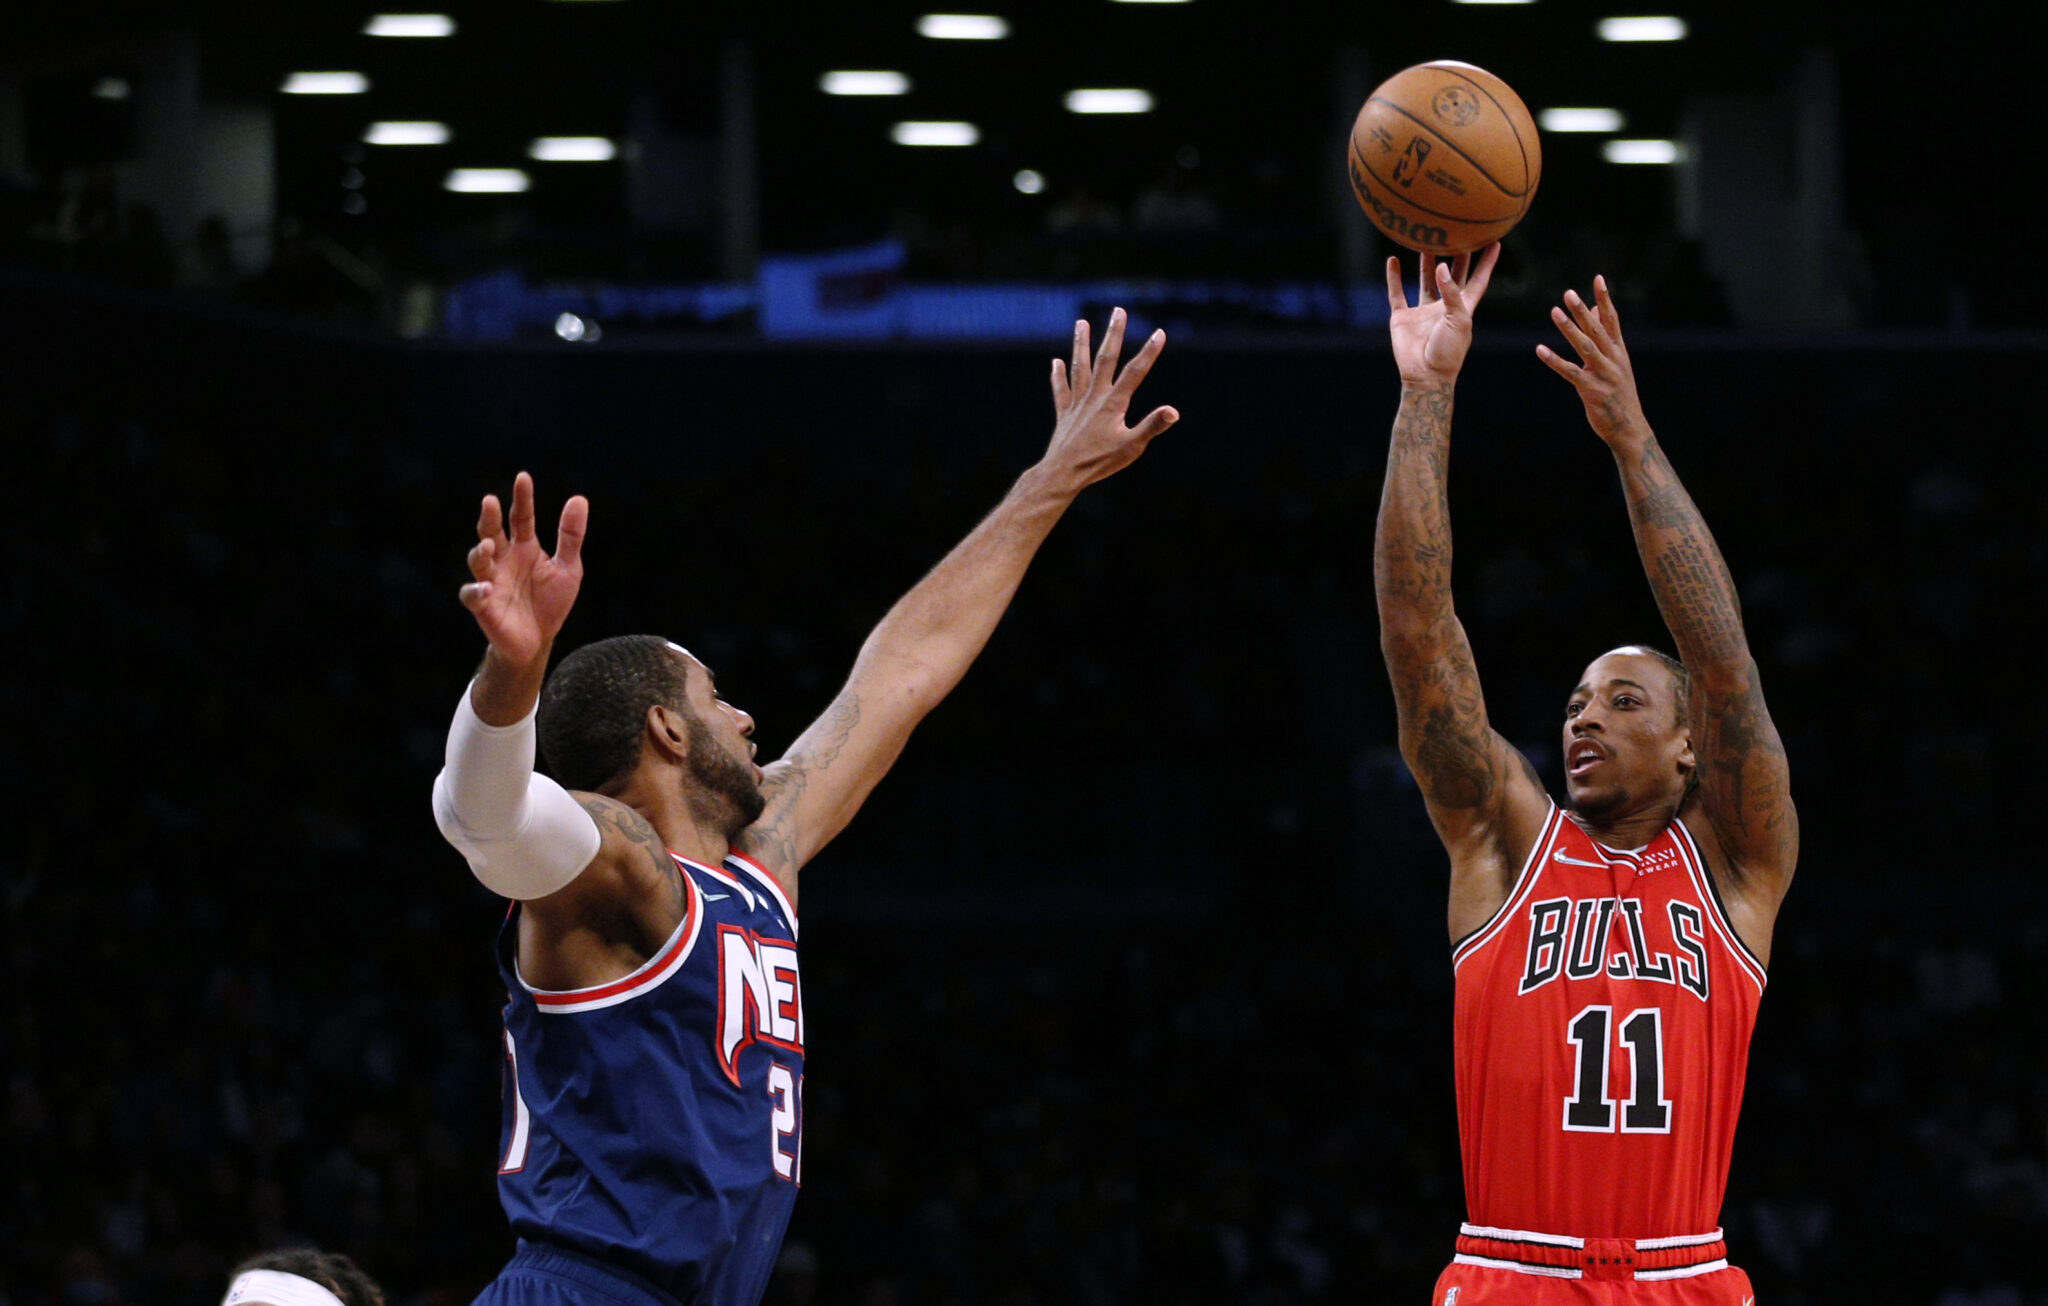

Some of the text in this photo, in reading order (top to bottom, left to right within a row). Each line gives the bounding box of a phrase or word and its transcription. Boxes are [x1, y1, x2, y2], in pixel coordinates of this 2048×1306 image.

[1637, 860, 1679, 877] EWEAR
[716, 922, 804, 1088] NE
[1562, 1004, 1672, 1134] 11
[767, 1060, 804, 1188] 2
